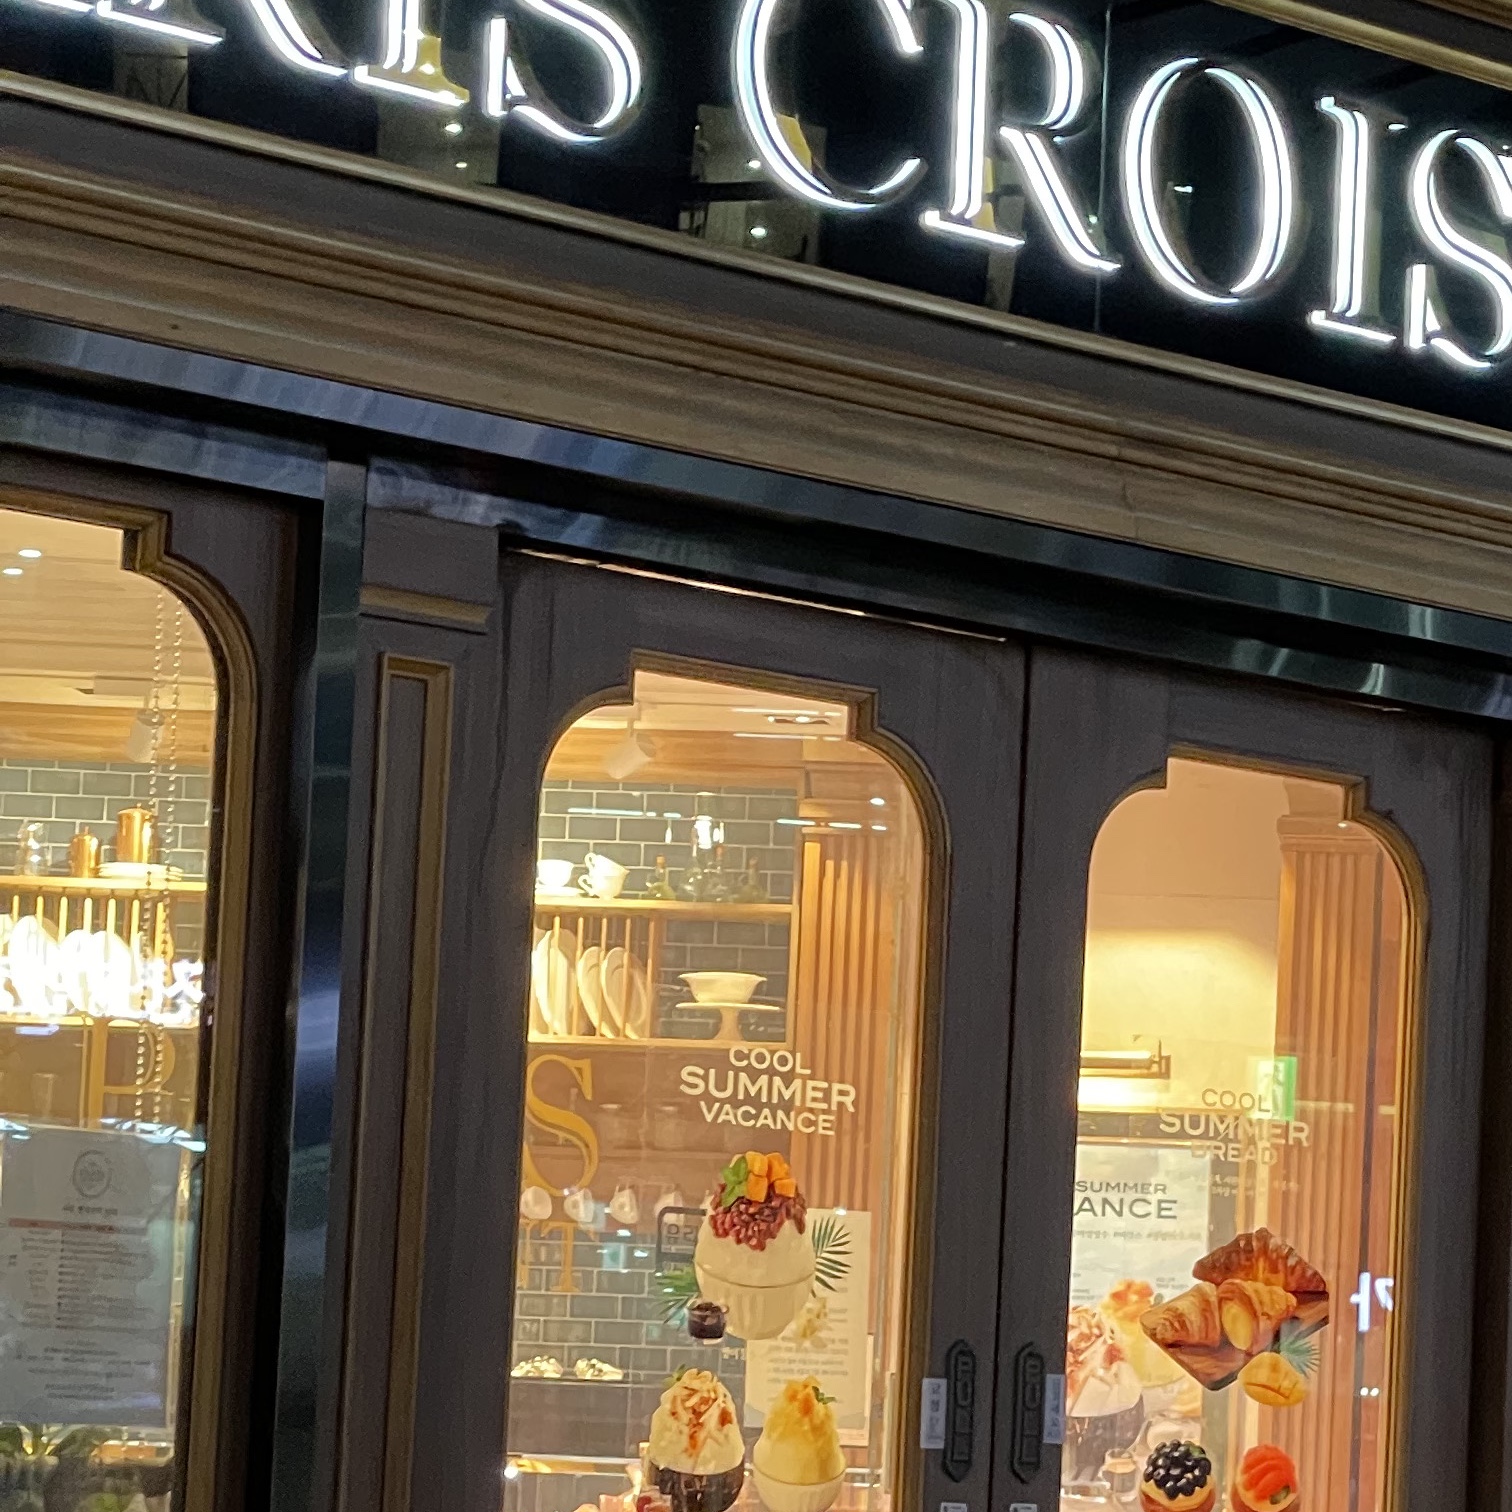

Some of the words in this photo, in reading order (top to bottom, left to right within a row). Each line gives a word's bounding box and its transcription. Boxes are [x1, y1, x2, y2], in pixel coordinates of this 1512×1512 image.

[728, 1045, 811, 1075] COOL
[679, 1065, 856, 1112] SUMMER
[1201, 1088, 1271, 1113] COOL
[699, 1101, 836, 1136] VACANCE
[1159, 1111, 1310, 1147] SUMMER
[1191, 1141, 1278, 1166] BREAD
[1076, 1179, 1168, 1195] SUMMER
